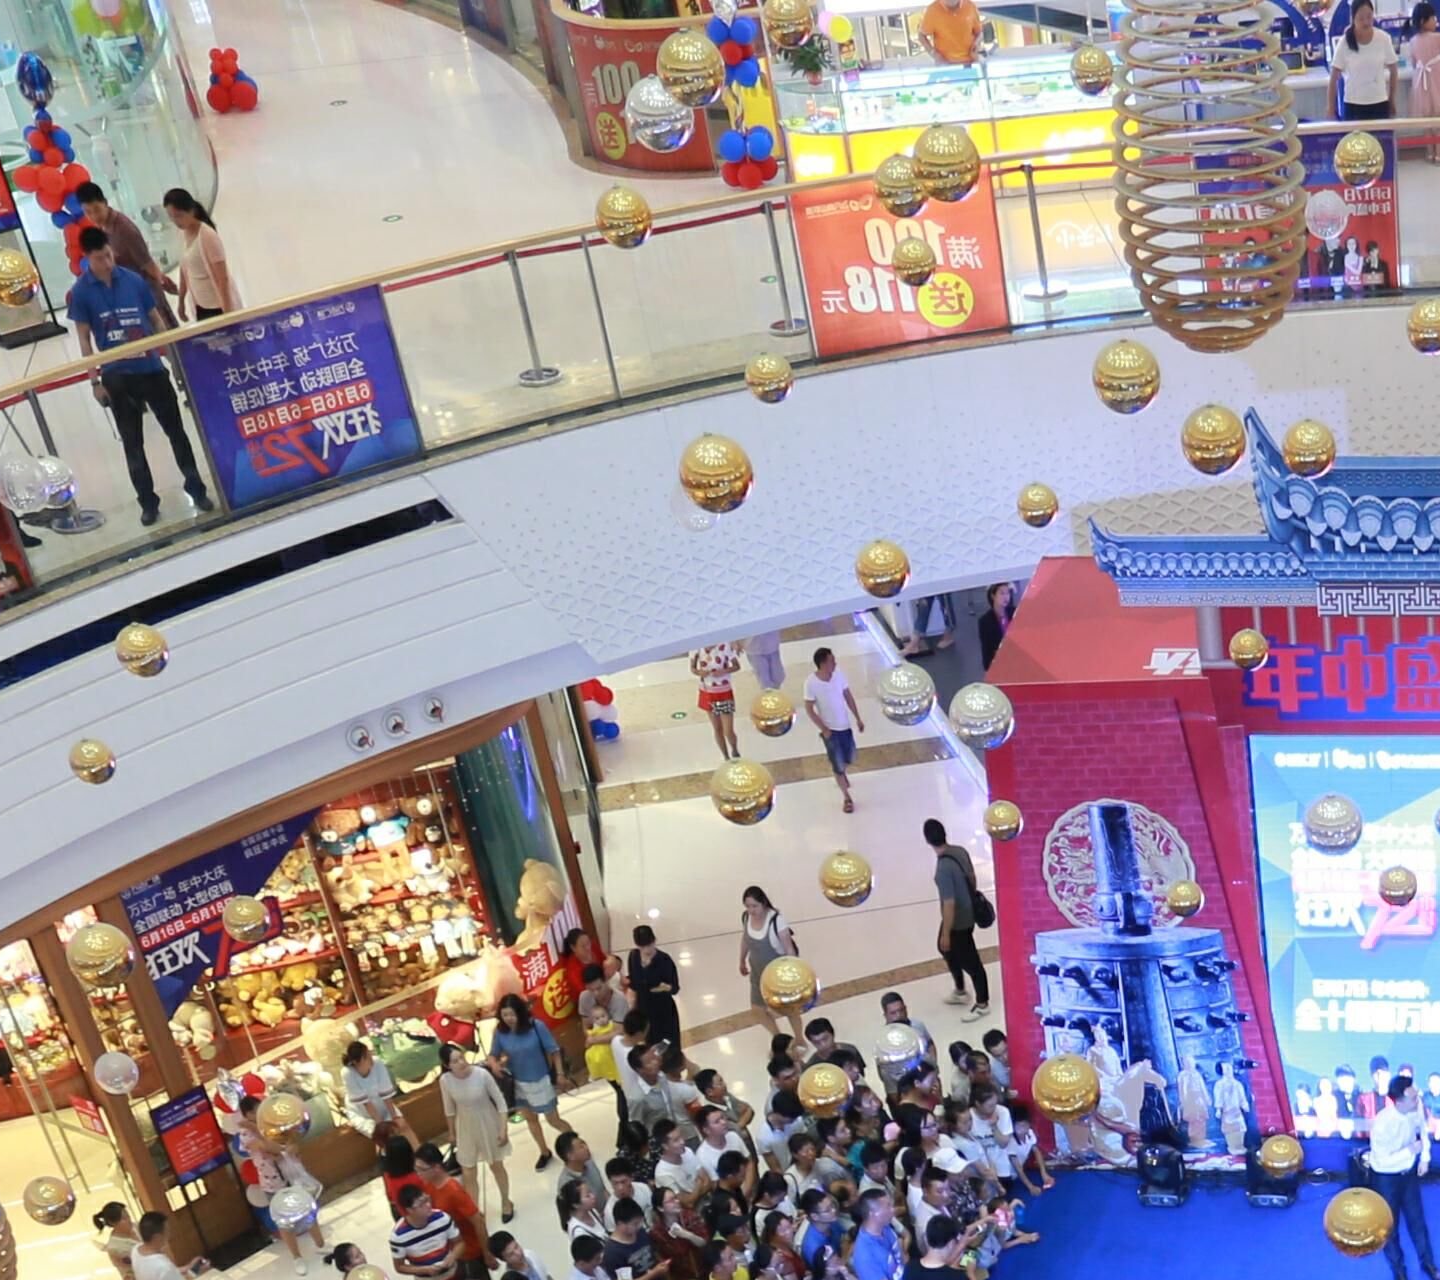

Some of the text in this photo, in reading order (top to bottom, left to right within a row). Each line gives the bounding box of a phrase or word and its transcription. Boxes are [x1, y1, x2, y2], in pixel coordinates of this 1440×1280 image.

[127, 886, 177, 919] 万达广场
[177, 864, 228, 894] 年中大庆
[133, 903, 183, 934] 全国联动
[185, 880, 234, 911] 大型促销
